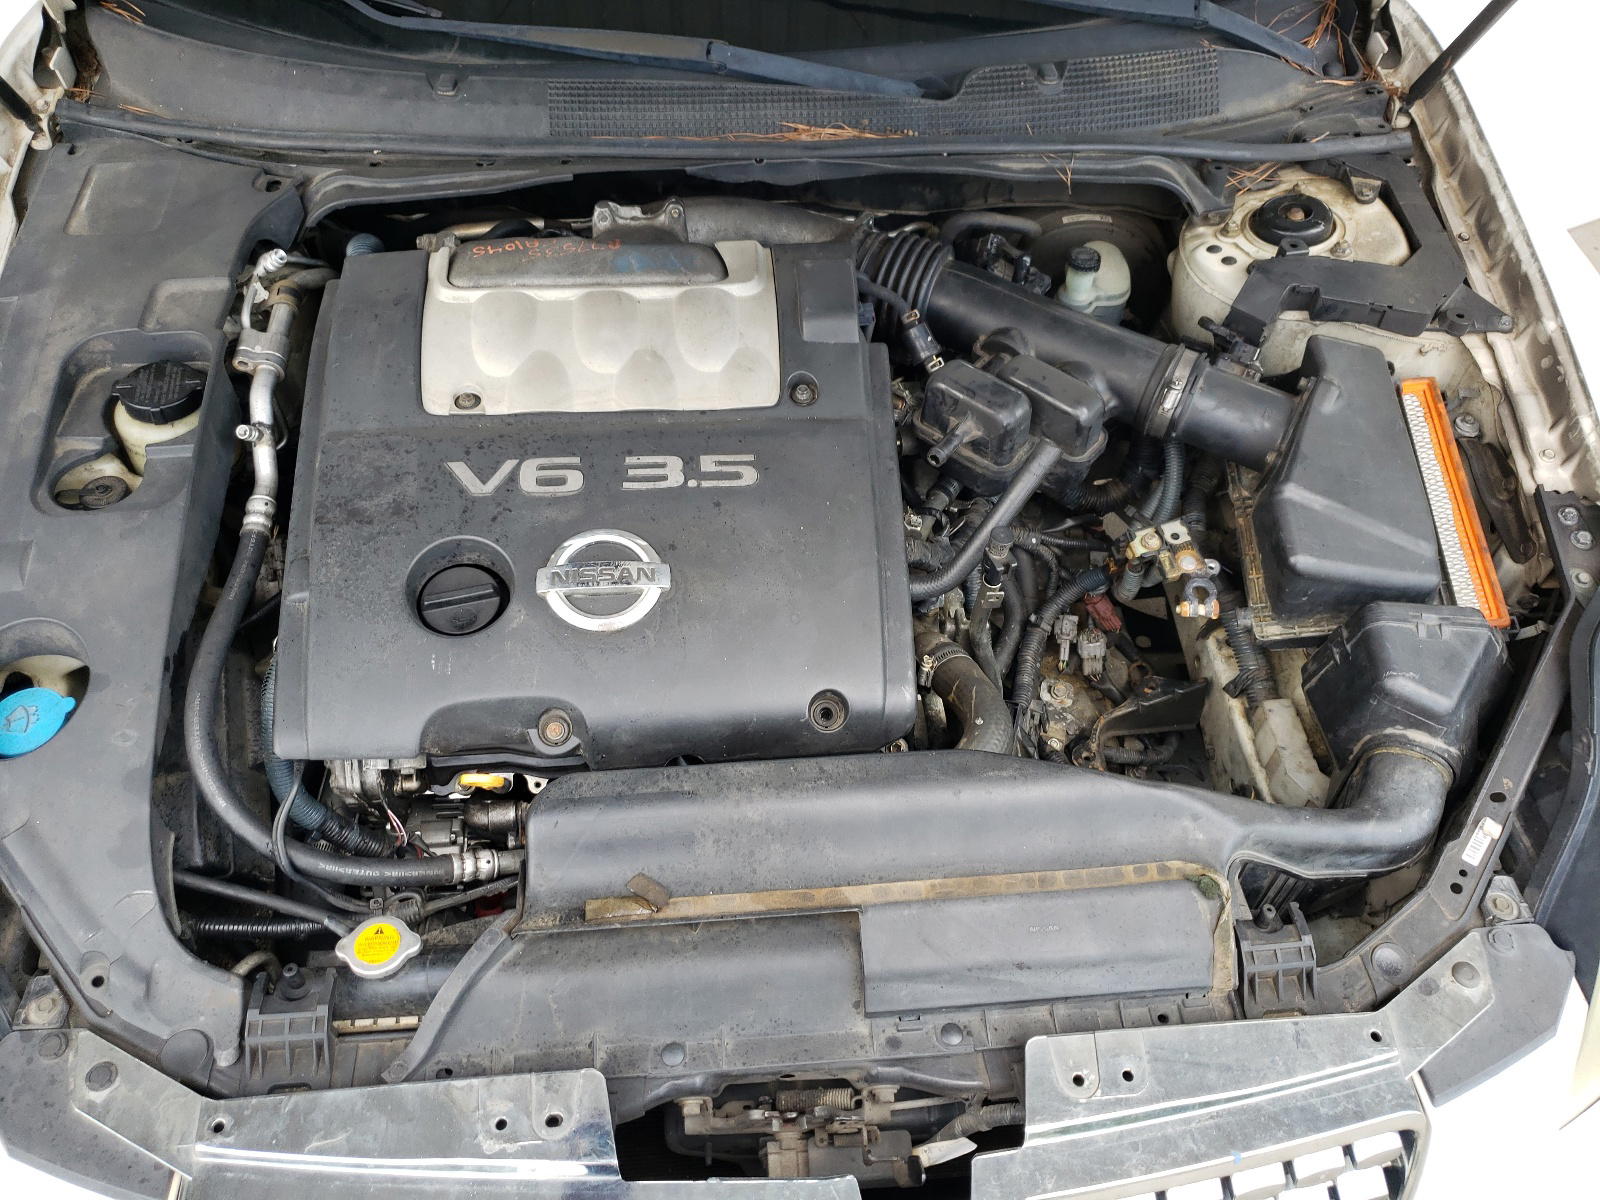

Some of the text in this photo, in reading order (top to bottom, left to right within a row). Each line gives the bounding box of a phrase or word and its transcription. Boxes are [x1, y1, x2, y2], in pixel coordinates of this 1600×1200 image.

[447, 454, 759, 497] V6 3.5
[551, 565, 657, 585] NISSAN
